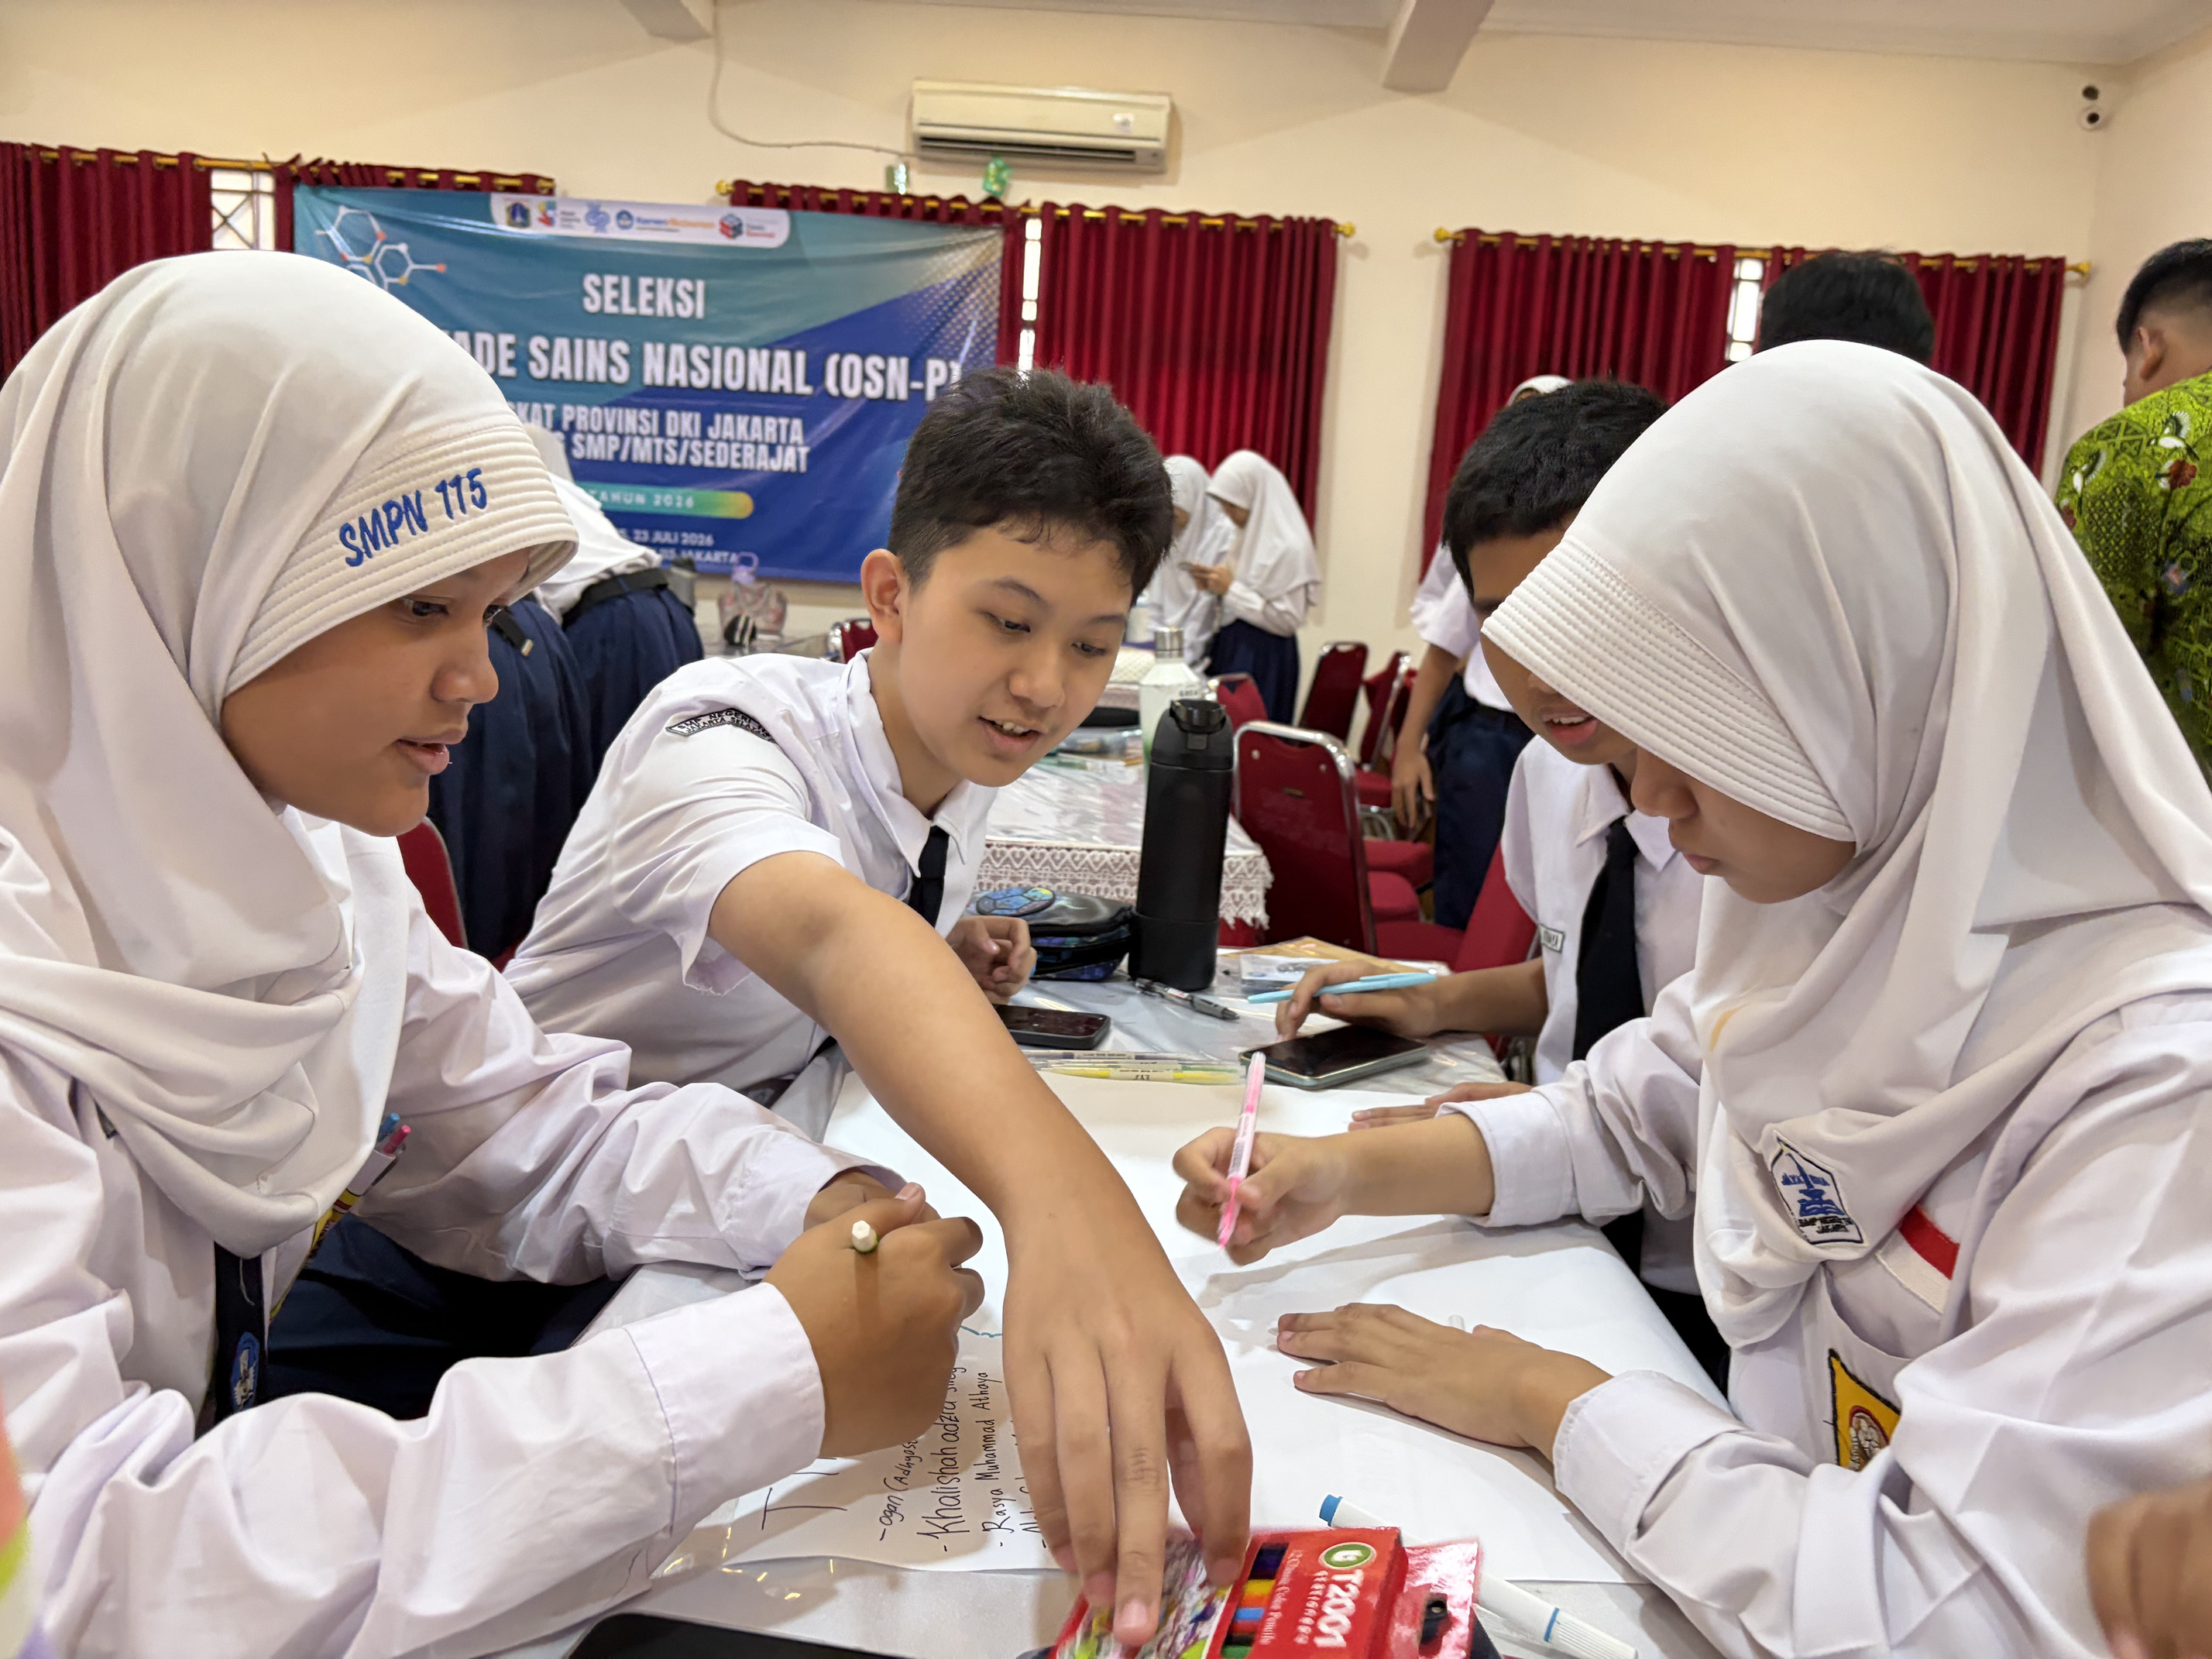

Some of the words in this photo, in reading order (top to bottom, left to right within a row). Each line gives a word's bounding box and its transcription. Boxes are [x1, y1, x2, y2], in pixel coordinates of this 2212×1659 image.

[582, 273, 705, 319] SELEKSI
[528, 335, 630, 384] SAINS
[642, 342, 813, 396] NASIONAL
[507, 401, 556, 431] KAT
[562, 404, 659, 437] PROVINSI
[665, 410, 701, 438] DKI
[708, 414, 803, 445] JAKARTA
[572, 434, 811, 473] SMP/MTS/SEDERAJAT
[339, 489, 428, 567] SMPN
[434, 468, 487, 520] 115
[968, 1372, 1002, 1410] Athaya
[973, 1418, 1001, 1481] Muhammad
[982, 1487, 1016, 1534] Rasya
